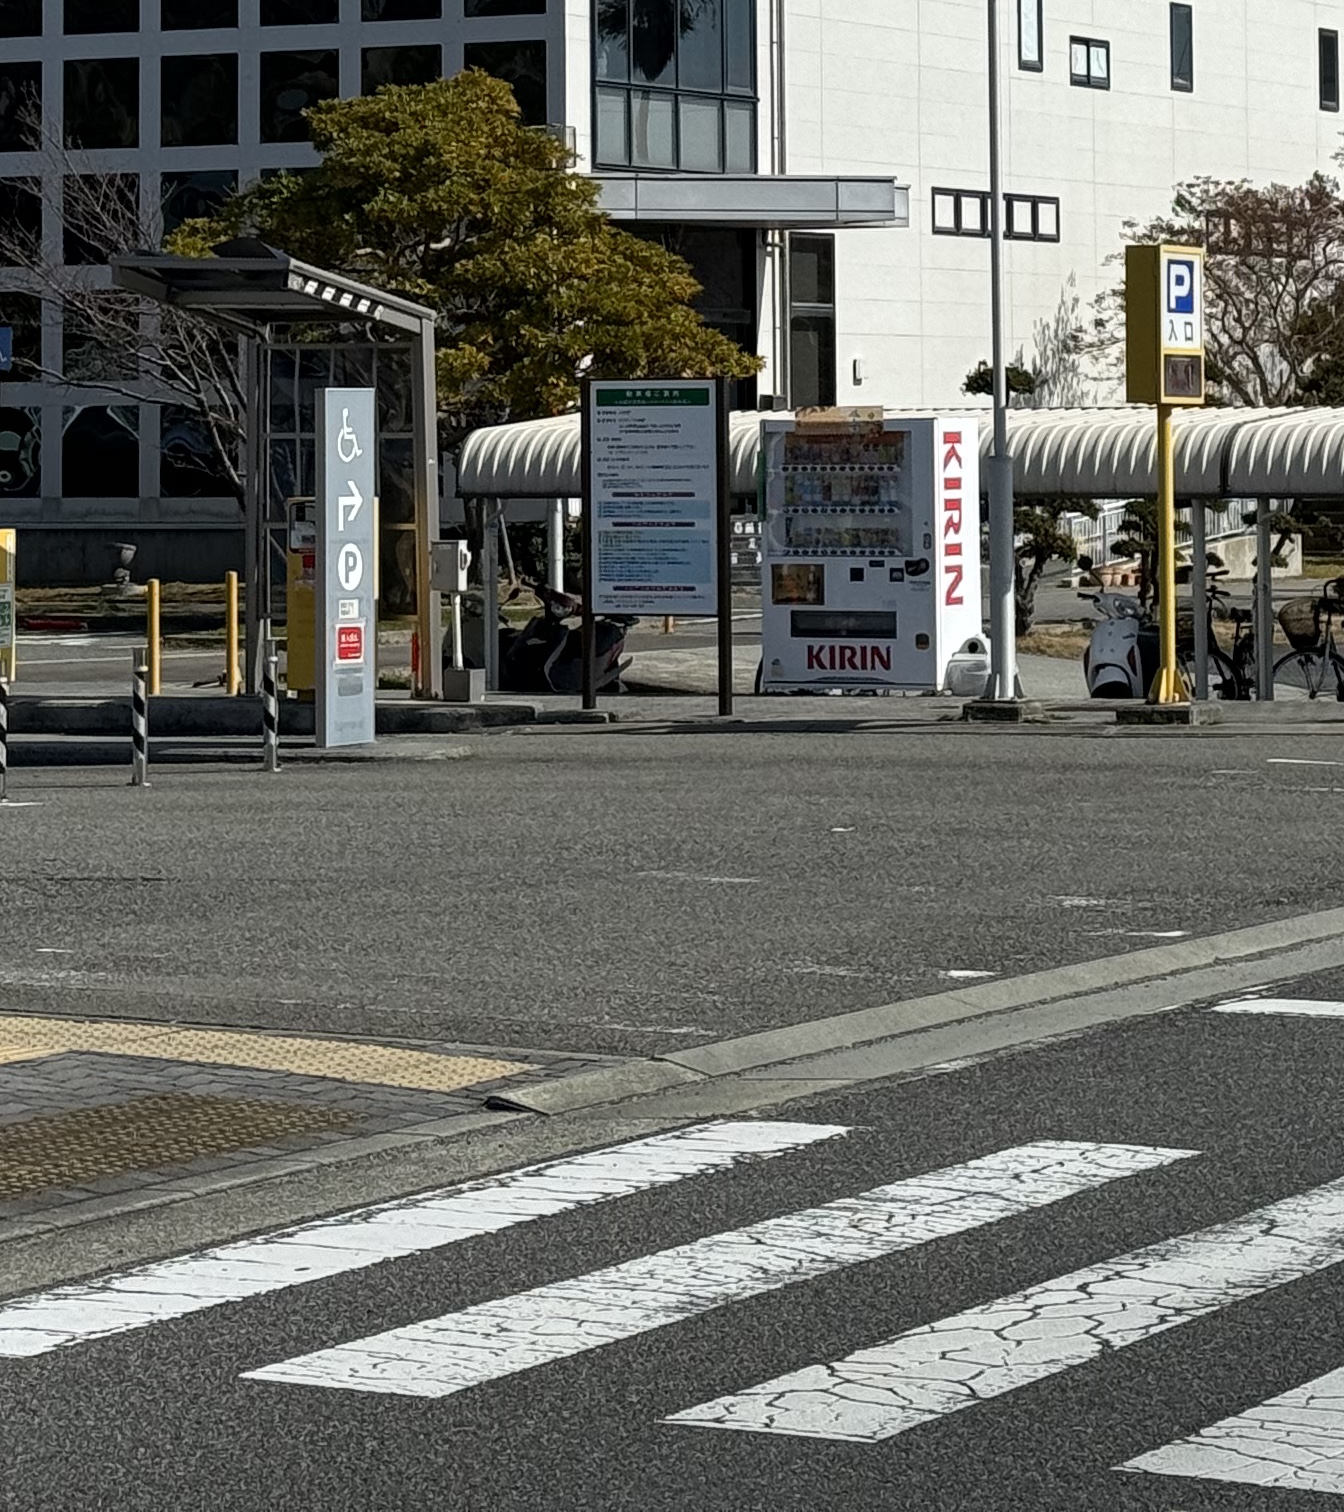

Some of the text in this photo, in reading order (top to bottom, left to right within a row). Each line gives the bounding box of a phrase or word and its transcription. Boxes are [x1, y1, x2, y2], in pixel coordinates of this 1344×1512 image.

[1168, 319, 1194, 343] 入口
[943, 430, 964, 607] KIRIN
[807, 644, 892, 671] KIRIN
